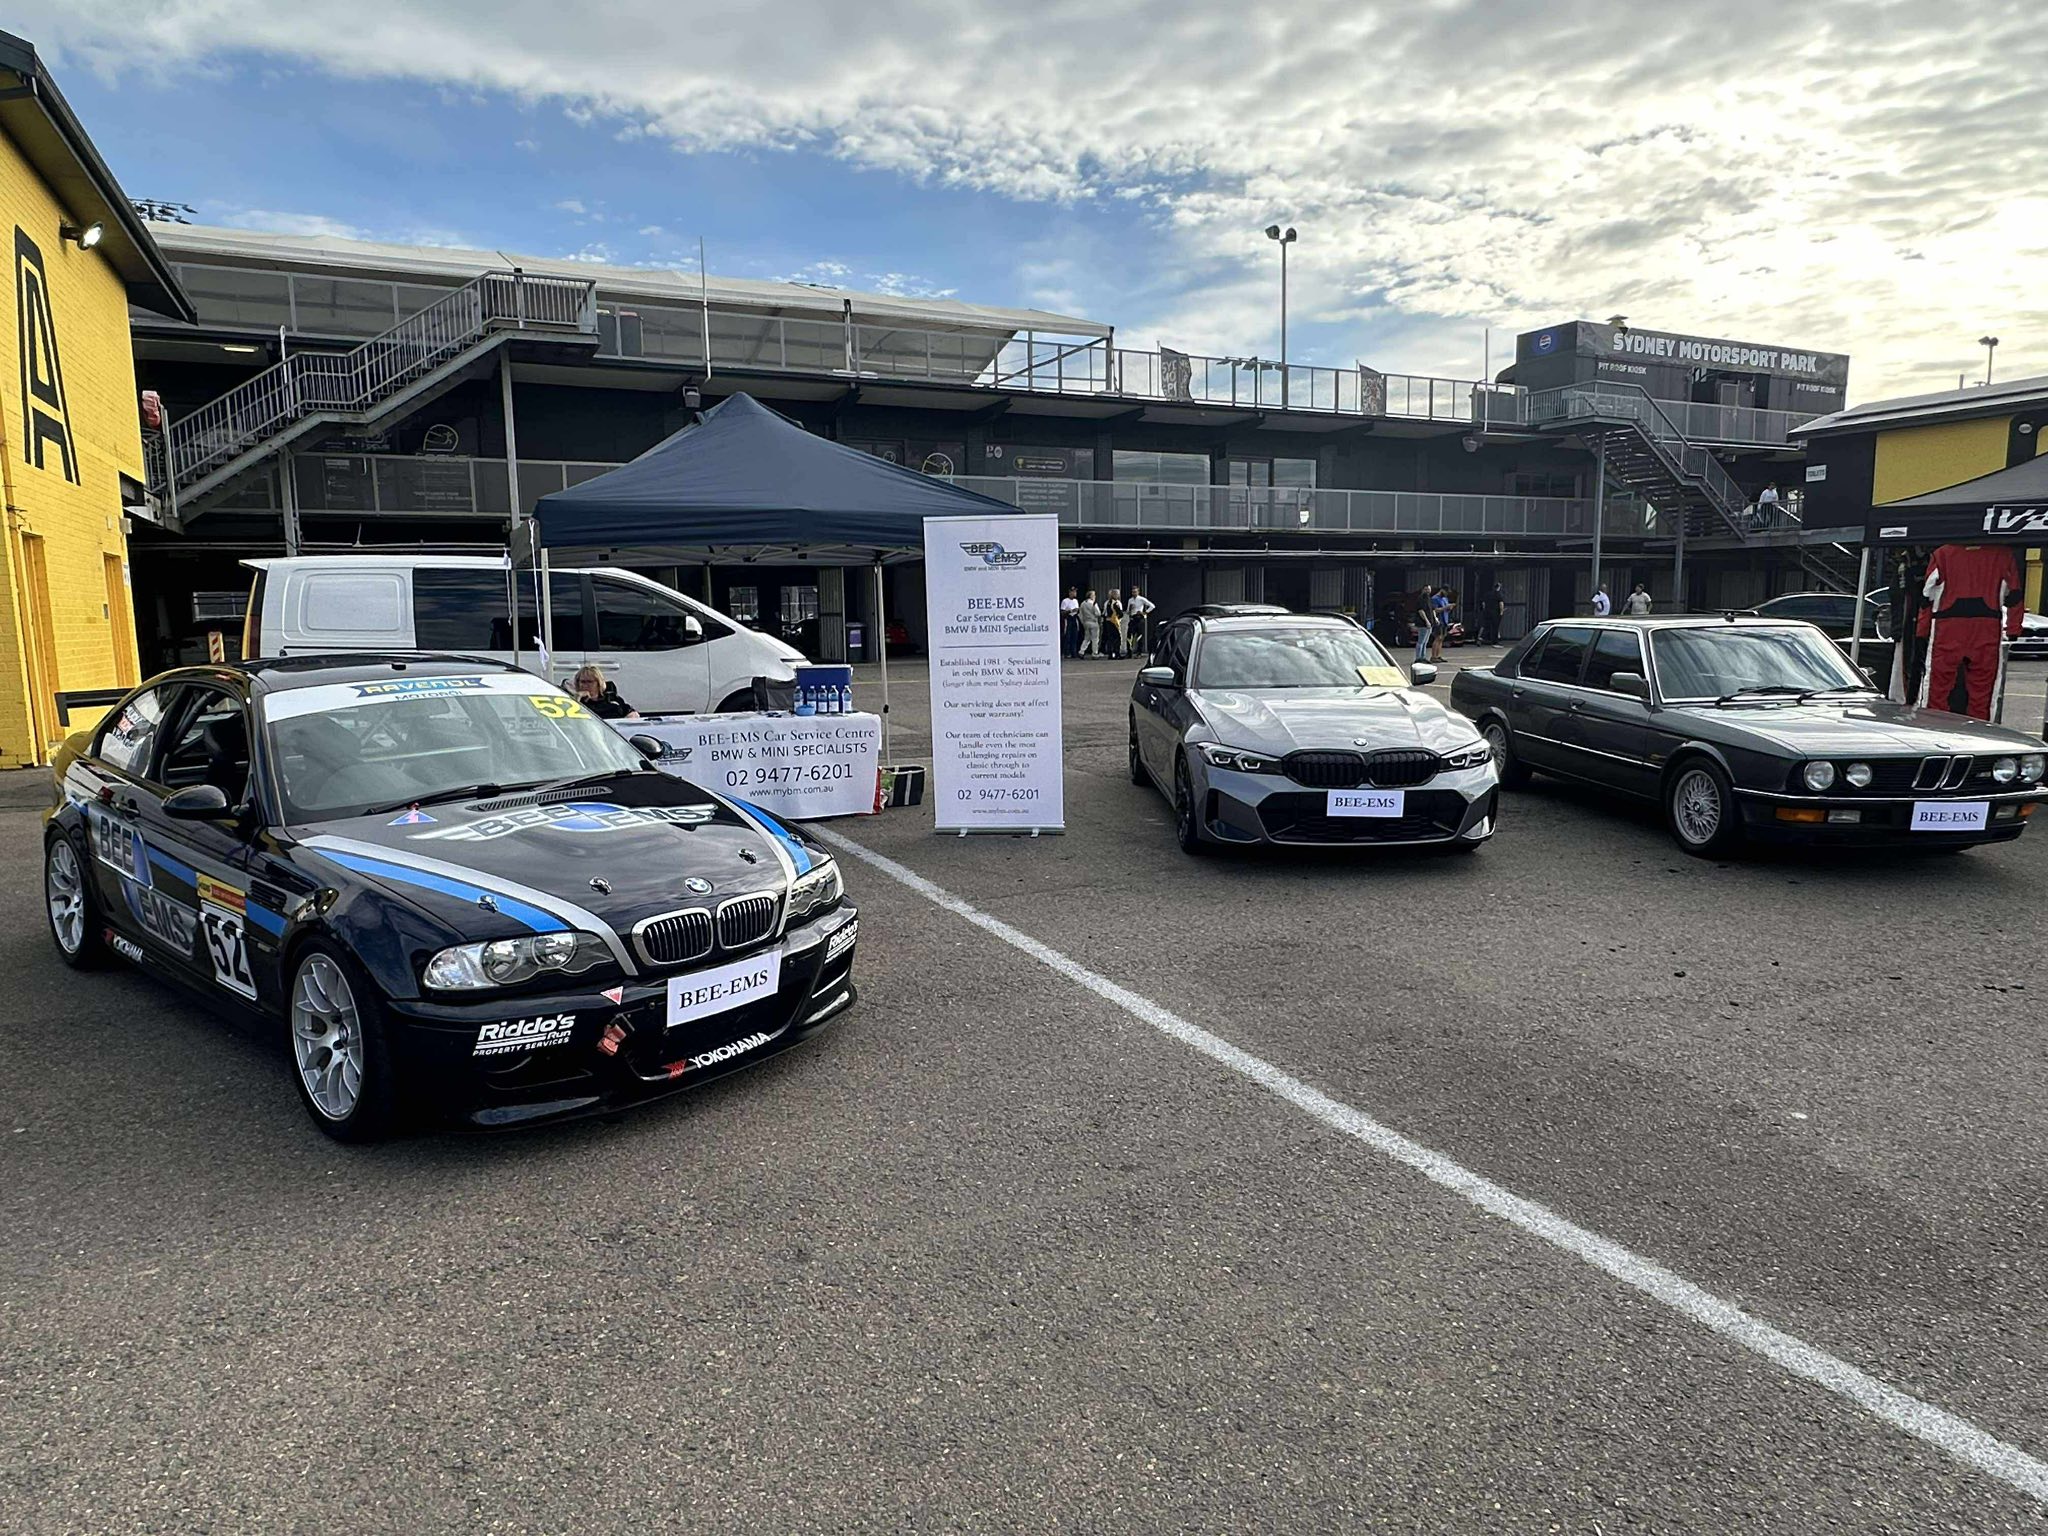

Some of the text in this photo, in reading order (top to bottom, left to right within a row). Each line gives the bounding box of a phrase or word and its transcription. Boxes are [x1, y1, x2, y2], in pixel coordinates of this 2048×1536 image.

[1613, 333, 1817, 373] SYDNEY MOTORSPORT PARK
[1598, 362, 1647, 375] PIT ROOF KIOSK
[970, 544, 993, 554] BEE
[994, 555, 1019, 563] EMS
[967, 597, 1025, 610] BEE-EMS
[956, 613, 1037, 623] Car Service Centre
[945, 624, 1050, 634] BMW & MINI Specialists
[940, 658, 981, 667] Established
[983, 658, 1000, 666] 1981
[1008, 658, 1051, 668] Specialising
[952, 668, 1039, 678] in only BMW & MINI
[365, 679, 478, 694] RAVENOL
[966, 680, 982, 688] than
[1000, 679, 1022, 688] Sydney
[528, 696, 592, 719] 52
[944, 700, 959, 709] Our
[961, 700, 994, 710] servicing
[995, 700, 1012, 708] does
[1014, 700, 1026, 708] not
[970, 709, 1025, 719] your warranty!
[698, 727, 875, 746] BEE-EMS Car Service Centre
[945, 731, 960, 739] Our
[982, 731, 991, 739] of
[992, 731, 1034, 739] technicians
[959, 741, 983, 749] handle
[711, 742, 868, 762] BMW & MINI SPECIALISTS
[957, 751, 999, 760] challenging
[1001, 751, 1026, 760] repairs
[966, 761, 988, 769] classic
[990, 761, 1020, 770] through
[726, 763, 854, 787] 02 9477-6201
[1000, 771, 1026, 779] models
[749, 785, 834, 798] www.mybm.com.au
[957, 788, 1039, 800] 02 9477-6201
[1334, 796, 1395, 809] BEE-EMS
[469, 804, 575, 836] BEE
[598, 806, 709, 830] EMS
[1919, 811, 1979, 824] BEE-EMS
[100, 815, 136, 877] BEE
[137, 887, 194, 953] EMS
[205, 913, 253, 988] 52
[679, 969, 768, 1010] BEE-EMS
[478, 1014, 576, 1041] Riddo's
[546, 1030, 572, 1040] Run
[472, 1037, 570, 1056] PROPERTY SERVICES
[689, 1031, 772, 1069] YOKOHAMA
